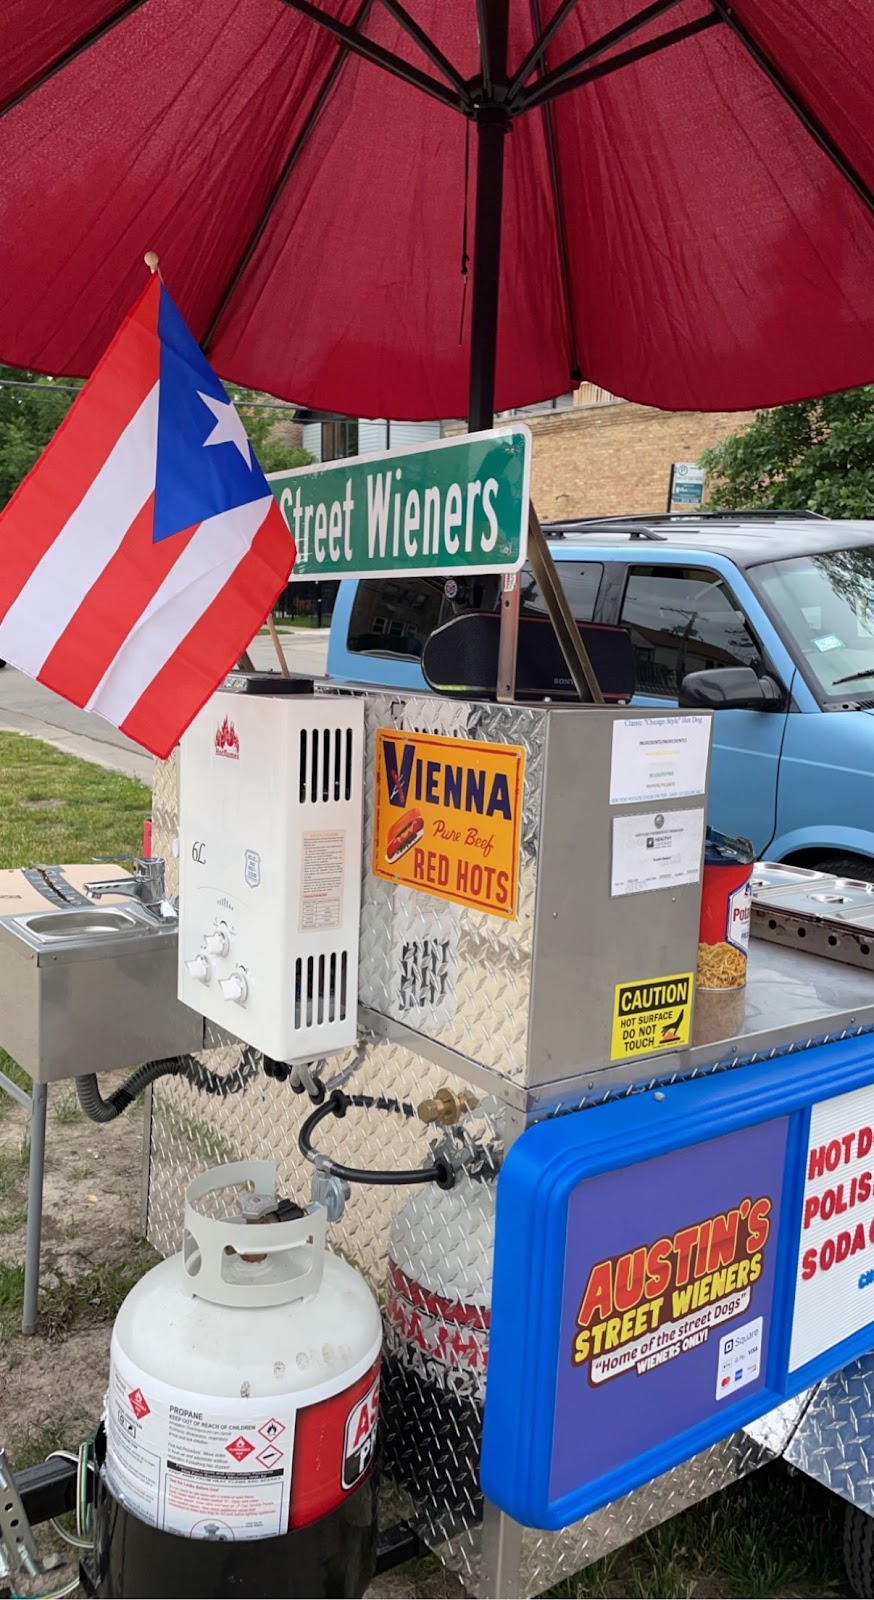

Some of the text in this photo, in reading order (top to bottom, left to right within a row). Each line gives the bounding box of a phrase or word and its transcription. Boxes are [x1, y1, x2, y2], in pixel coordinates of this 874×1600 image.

[280, 468, 499, 563] Street Wieners
[382, 740, 512, 820] VIENNA
[191, 841, 206, 865] 6L
[432, 820, 494, 857] Pure Beef
[414, 847, 509, 904] RED HOTS
[621, 982, 687, 1012] CAUTION
[620, 1011, 673, 1028] HOT SURFACE
[623, 1024, 657, 1040] DO NOT
[624, 1037, 655, 1052] TOUCH
[808, 1126, 874, 1180] HOT D
[803, 1171, 874, 1229] POLIS
[578, 1198, 771, 1326] AUSTIN'S
[801, 1222, 866, 1281] SODA
[574, 1252, 762, 1363] STREET WIENERS
[636, 1328, 709, 1374] WIENERS ONLY!
[640, 1337, 655, 1355] of
[657, 1328, 675, 1347] the
[677, 1312, 711, 1338] street
[735, 1329, 759, 1347] Square
[748, 1346, 758, 1355] VISA
[169, 1405, 203, 1420] PROPANE
[169, 1414, 181, 1422] KEEP
[201, 1422, 220, 1430] REACH
